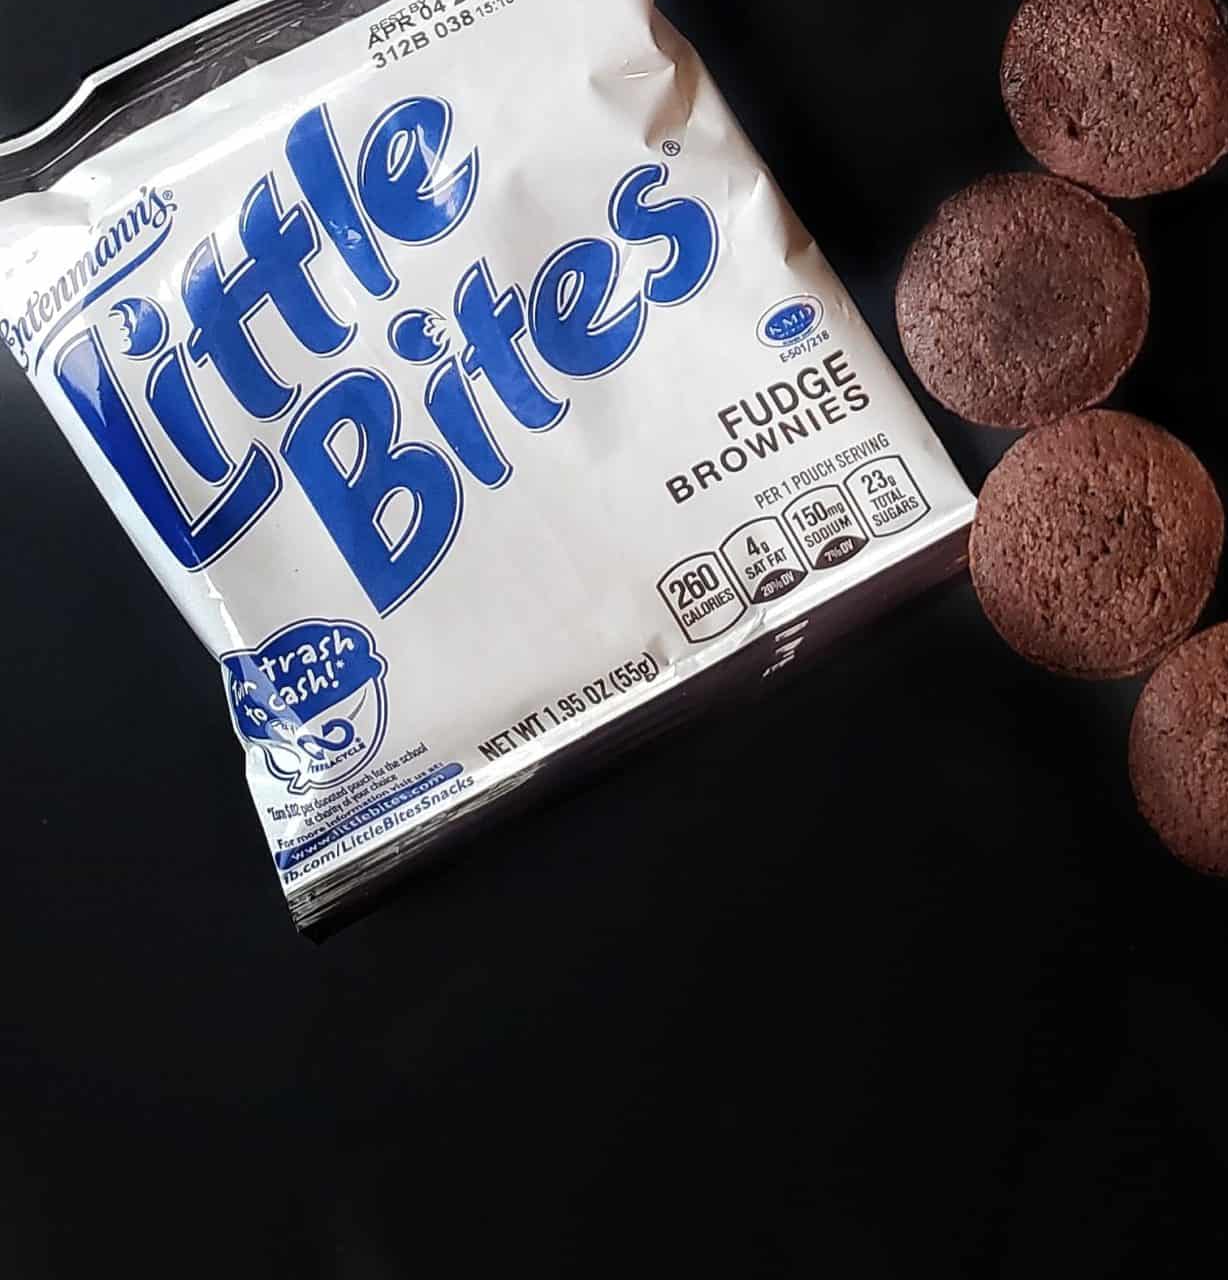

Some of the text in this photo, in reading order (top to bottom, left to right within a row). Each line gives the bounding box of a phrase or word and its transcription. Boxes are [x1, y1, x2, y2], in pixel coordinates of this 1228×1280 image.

[368, 15, 416, 49] APR
[369, 8, 406, 34] BEST
[372, 31, 430, 68] 312B
[434, 10, 474, 38] 038
[54, 96, 478, 573] Little
[280, 163, 719, 618] Bites
[718, 350, 856, 440] FUDGE
[665, 385, 870, 504] BROWNIES
[754, 432, 890, 510] PER 1 POUCH SERVING
[870, 487, 905, 510] TOTAL
[872, 497, 919, 527] SUGARS
[746, 536, 770, 556] 4g
[804, 515, 852, 548] SODIUM
[669, 563, 720, 609] 260
[745, 548, 788, 580] SAT FAT
[682, 588, 735, 627] CALORIES
[259, 630, 354, 681] trash
[244, 704, 268, 726] to
[478, 652, 660, 762] NET WT 1.95 OZ (55g)
[348, 774, 374, 794] pouch
[384, 761, 400, 772] the
[400, 742, 428, 764] school
[277, 838, 294, 848] For
[297, 827, 326, 842] more
[326, 790, 390, 827] information
[391, 778, 412, 791] visit
[283, 775, 475, 885] fb.com/LittleBitesSnacks
